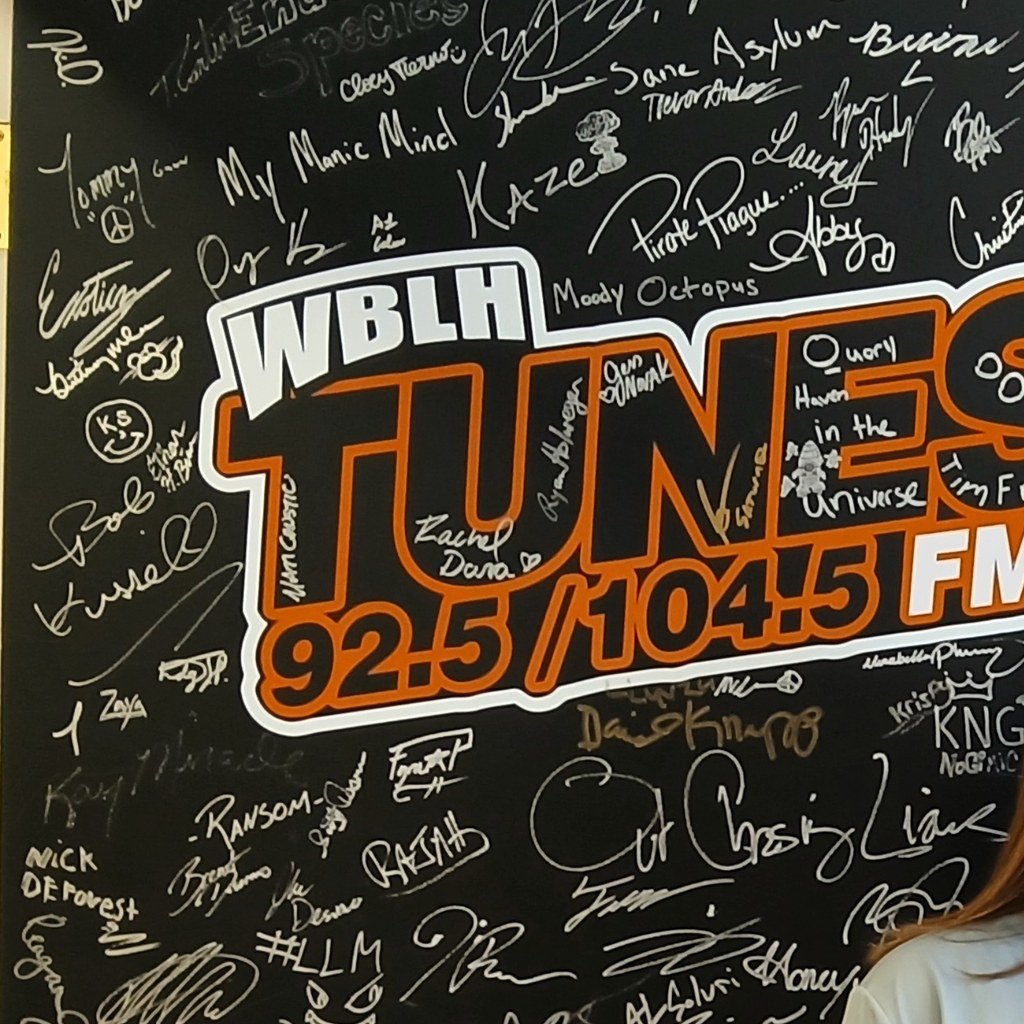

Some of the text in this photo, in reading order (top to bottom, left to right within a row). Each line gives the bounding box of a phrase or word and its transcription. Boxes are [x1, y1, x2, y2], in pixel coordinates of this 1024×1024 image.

[712, 18, 841, 70] Asylum
[216, 106, 458, 224] My Manic Mind
[588, 173, 698, 263] Pirate
[553, 275, 759, 315] Moody Octopus
[226, 264, 526, 421] WBLH
[794, 383, 850, 411] Haven
[814, 413, 897, 445] in the
[803, 479, 927, 520] Universe
[933, 705, 1024, 750] KNG
[255, 930, 382, 977] #LLM
